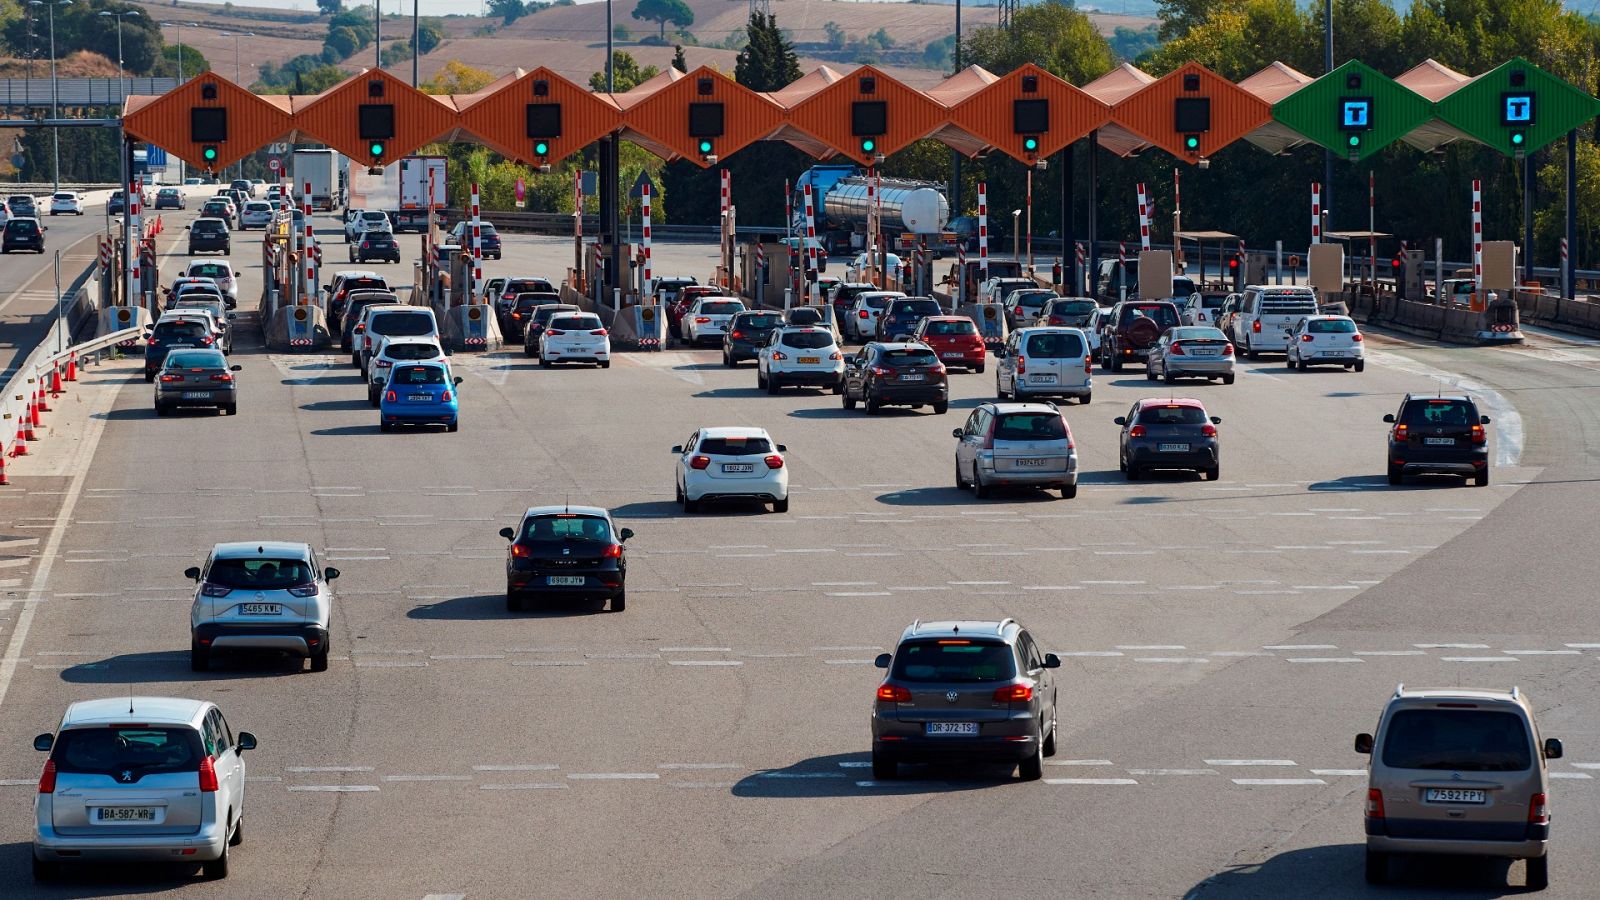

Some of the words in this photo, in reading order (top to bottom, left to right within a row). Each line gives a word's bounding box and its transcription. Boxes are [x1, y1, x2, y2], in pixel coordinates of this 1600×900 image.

[1348, 107, 1364, 122] T
[1510, 102, 1526, 117] T
[932, 722, 972, 732] DR-372-TS
[1434, 789, 1461, 800] 7592
[1463, 789, 1482, 801] FPY
[104, 809, 149, 819] BA-587-WR
